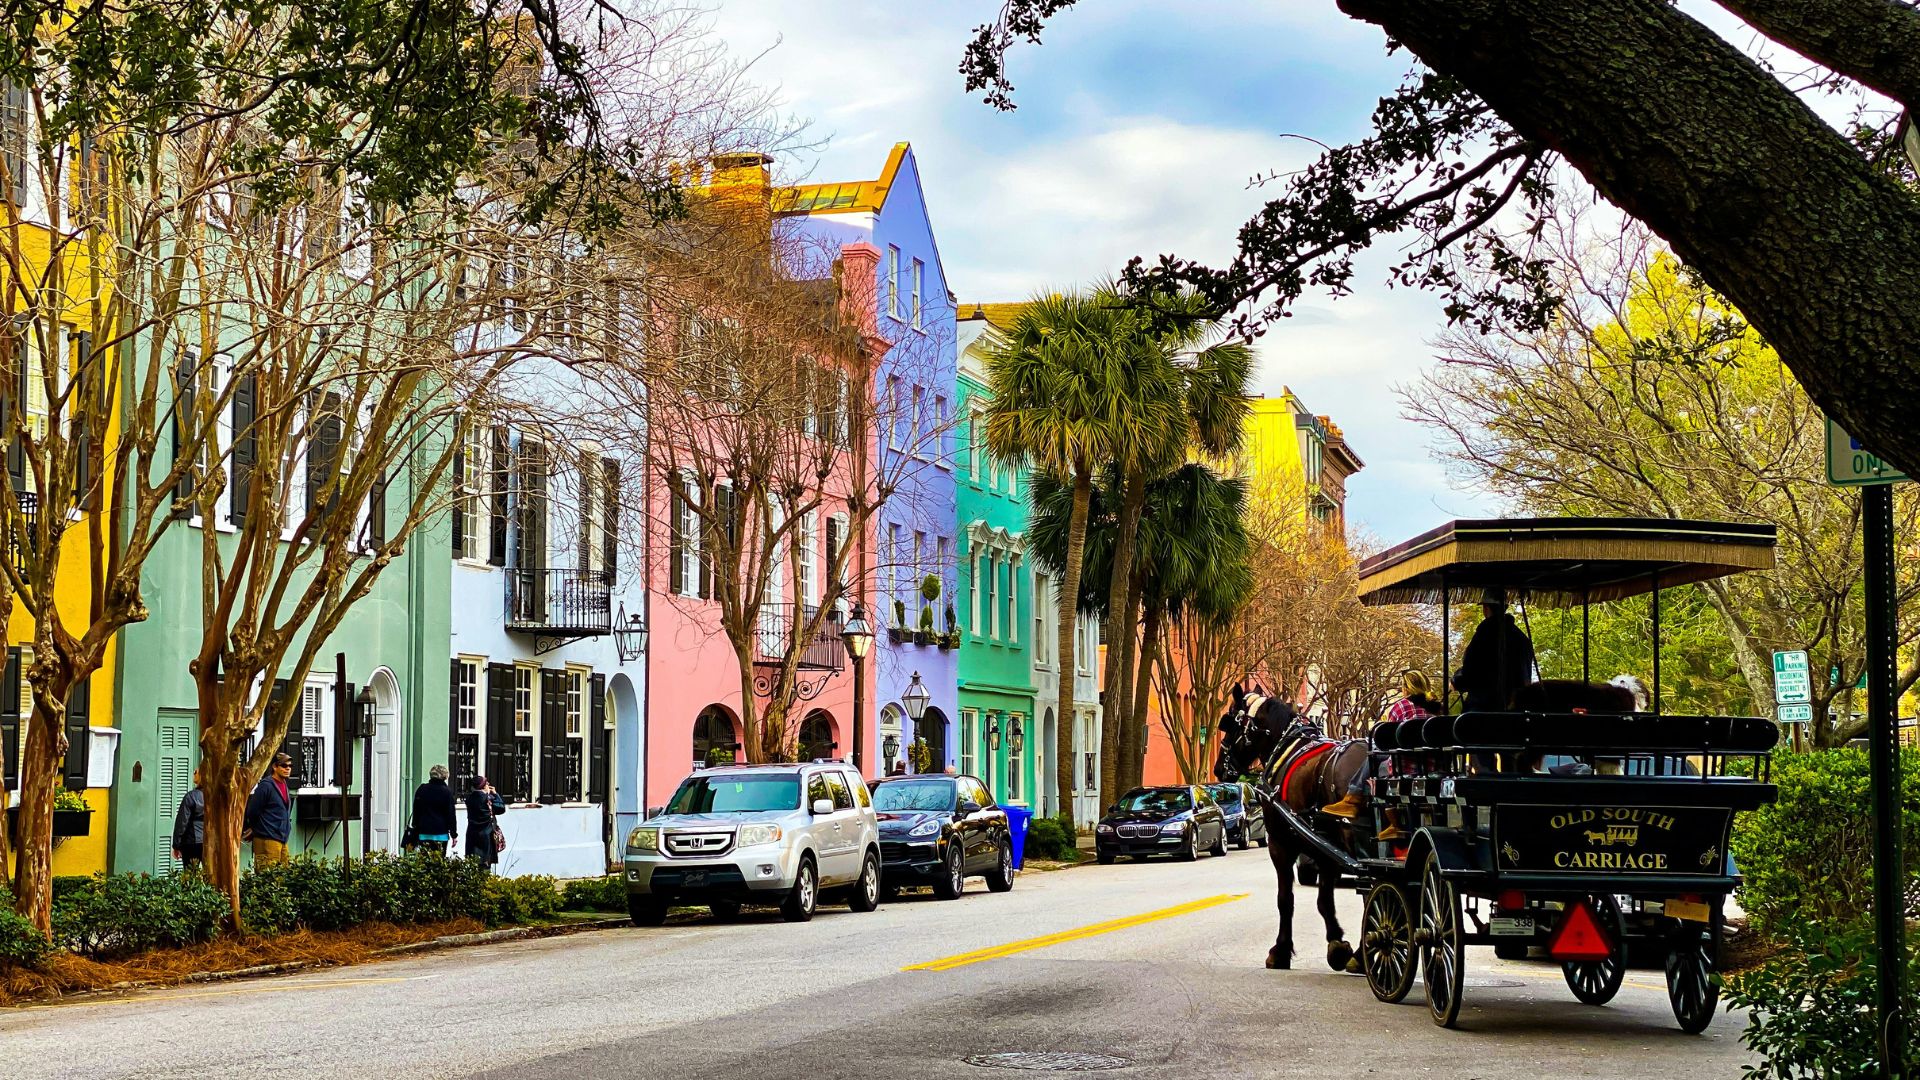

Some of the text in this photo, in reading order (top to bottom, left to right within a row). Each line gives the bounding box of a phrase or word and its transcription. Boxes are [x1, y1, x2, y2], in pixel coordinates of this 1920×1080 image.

[1853, 454, 1889, 474] ONL
[1785, 662, 1805, 670] PARKING
[1779, 672, 1804, 680] RESIDENTIAL
[1550, 808, 1676, 831] OLD SOUTH
[1554, 851, 1668, 869] CARRIAGE
[1514, 918, 1533, 928] 338
